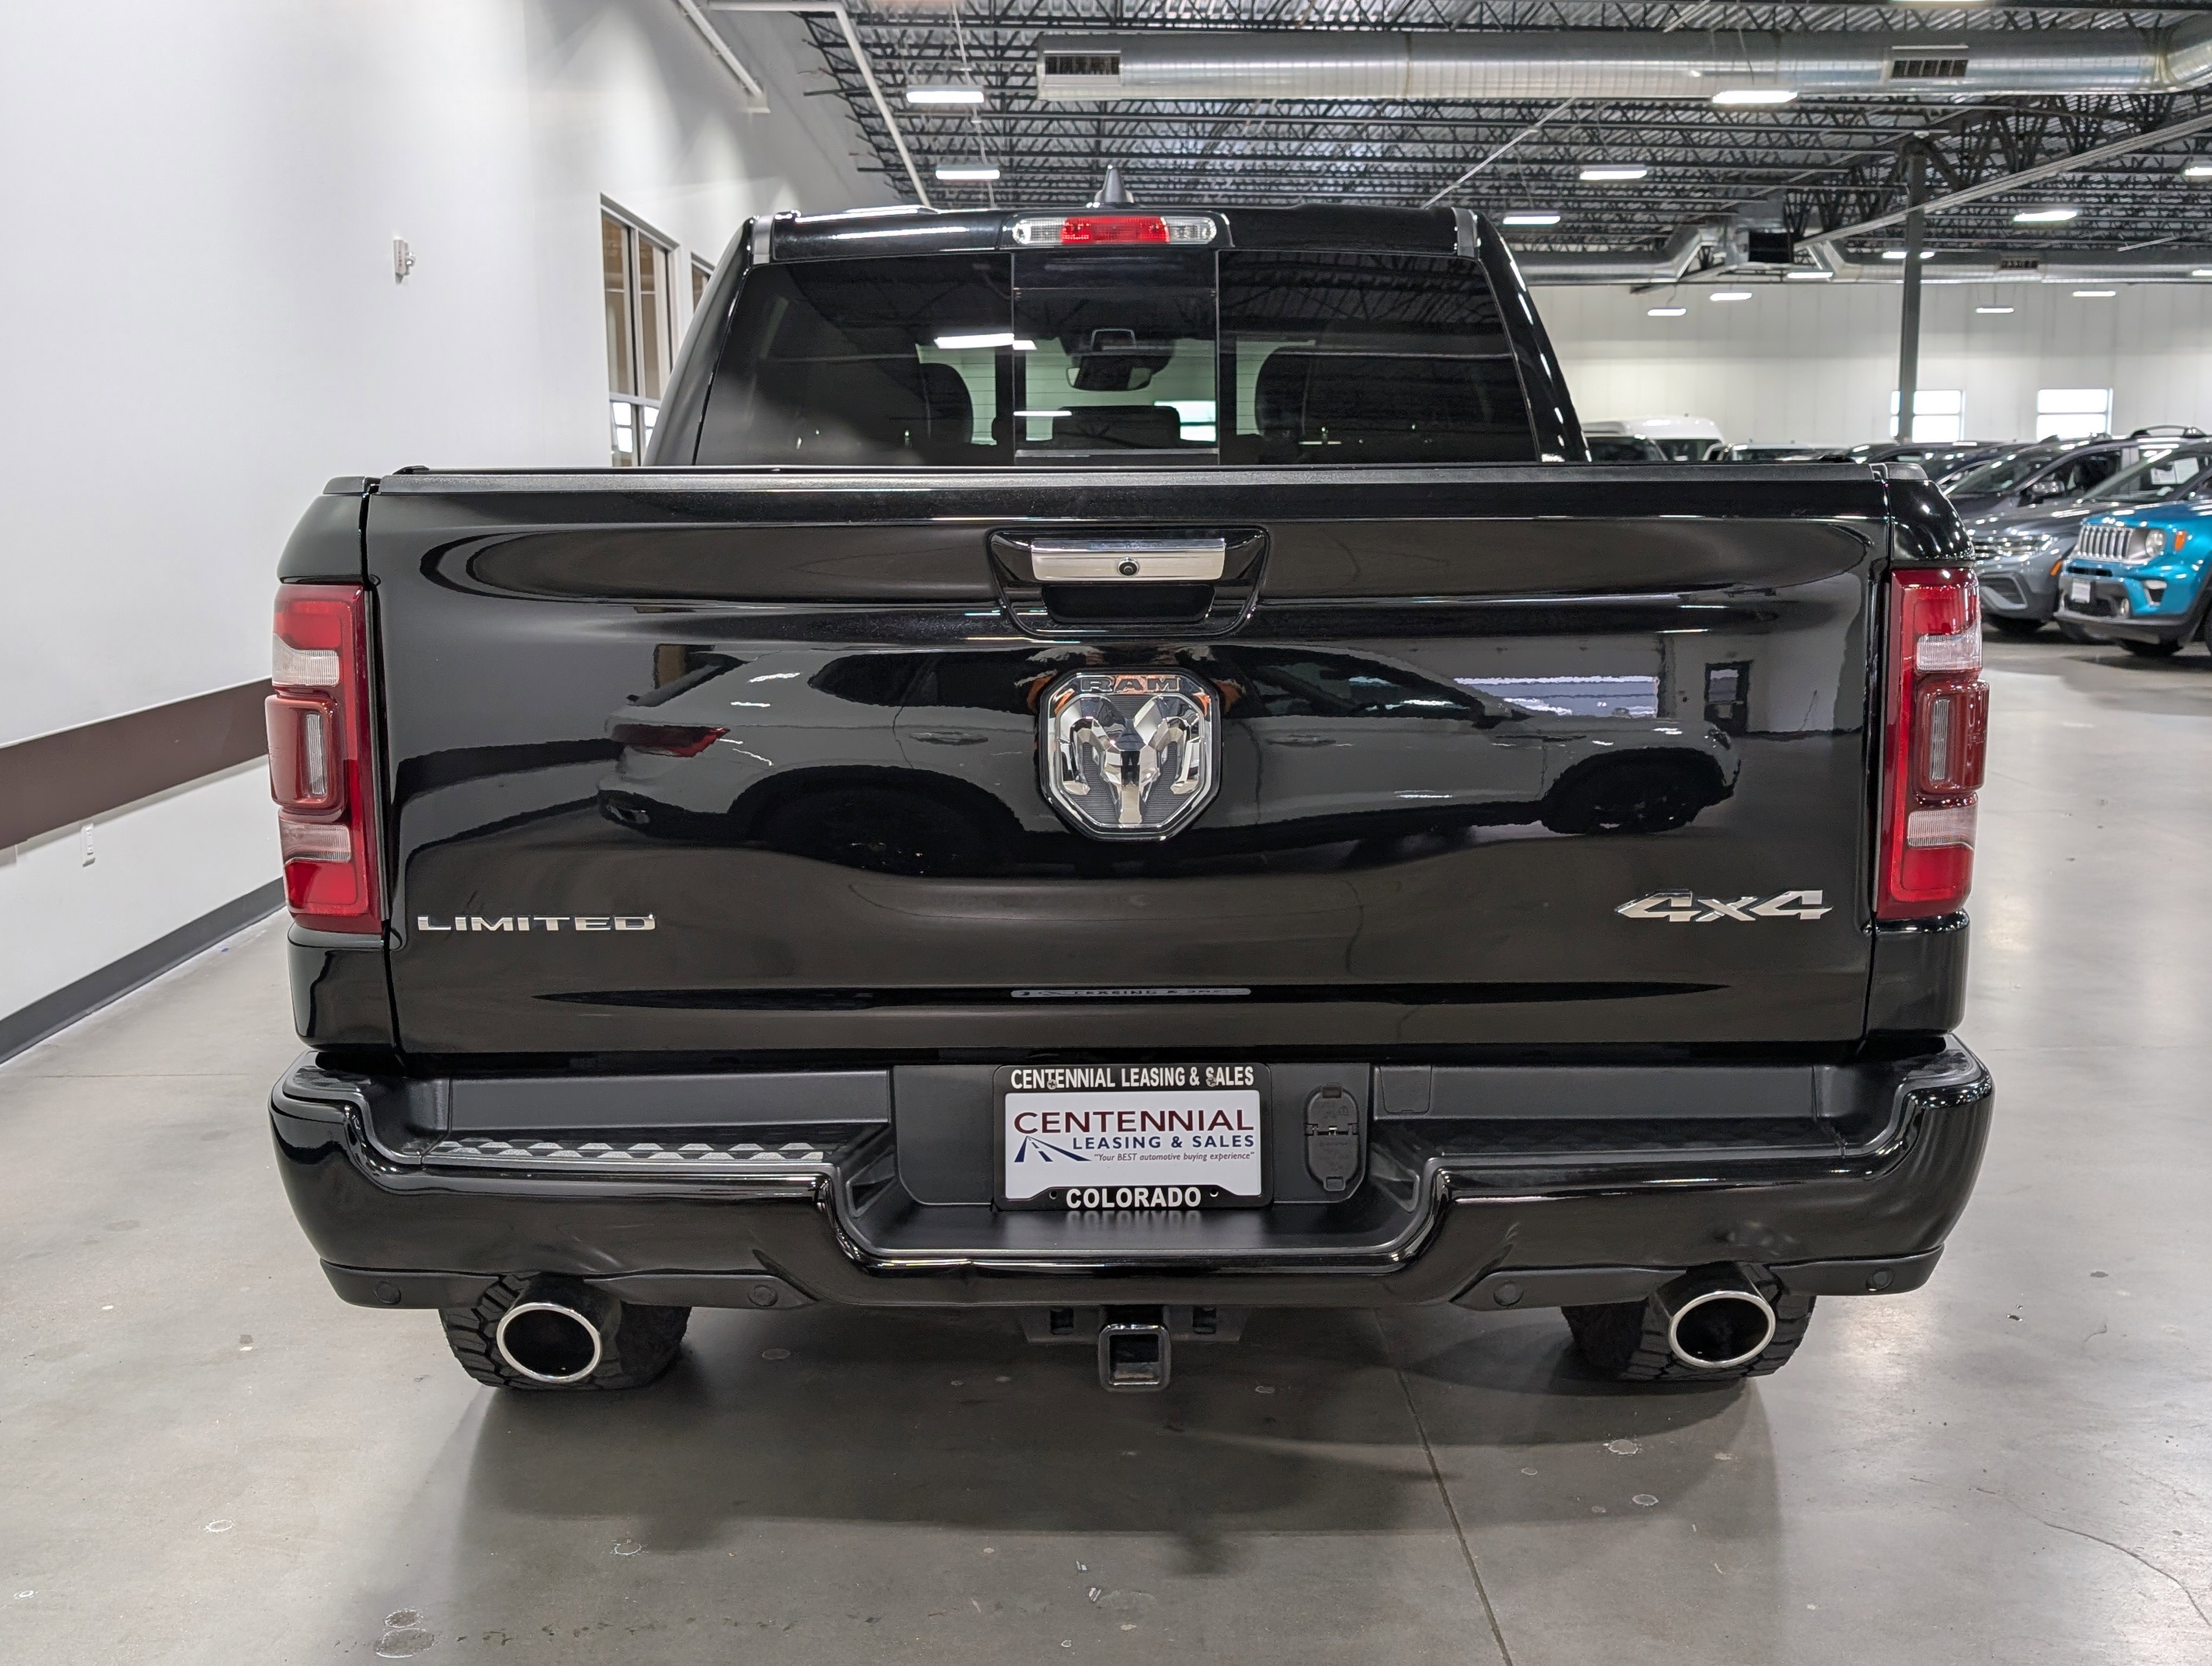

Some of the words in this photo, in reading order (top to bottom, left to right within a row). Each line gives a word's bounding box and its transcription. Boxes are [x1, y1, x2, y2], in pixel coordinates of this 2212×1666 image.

[1081, 677, 1181, 692] RAM
[417, 915, 657, 931] LIMITED
[1011, 1068, 1115, 1089] CENTENNIAL
[1121, 1067, 1185, 1087] LEASING
[1189, 1066, 1200, 1086] &
[1206, 1066, 1253, 1087] SALES
[1014, 1109, 1254, 1134] CENTENNIAL
[1073, 1136, 1161, 1150] LEASING
[1171, 1136, 1183, 1148] &
[1193, 1135, 1254, 1148] SALES
[1140, 1152, 1181, 1161] automotive
[1183, 1152, 1207, 1162] buying
[1066, 1187, 1201, 1208] COLORADO
